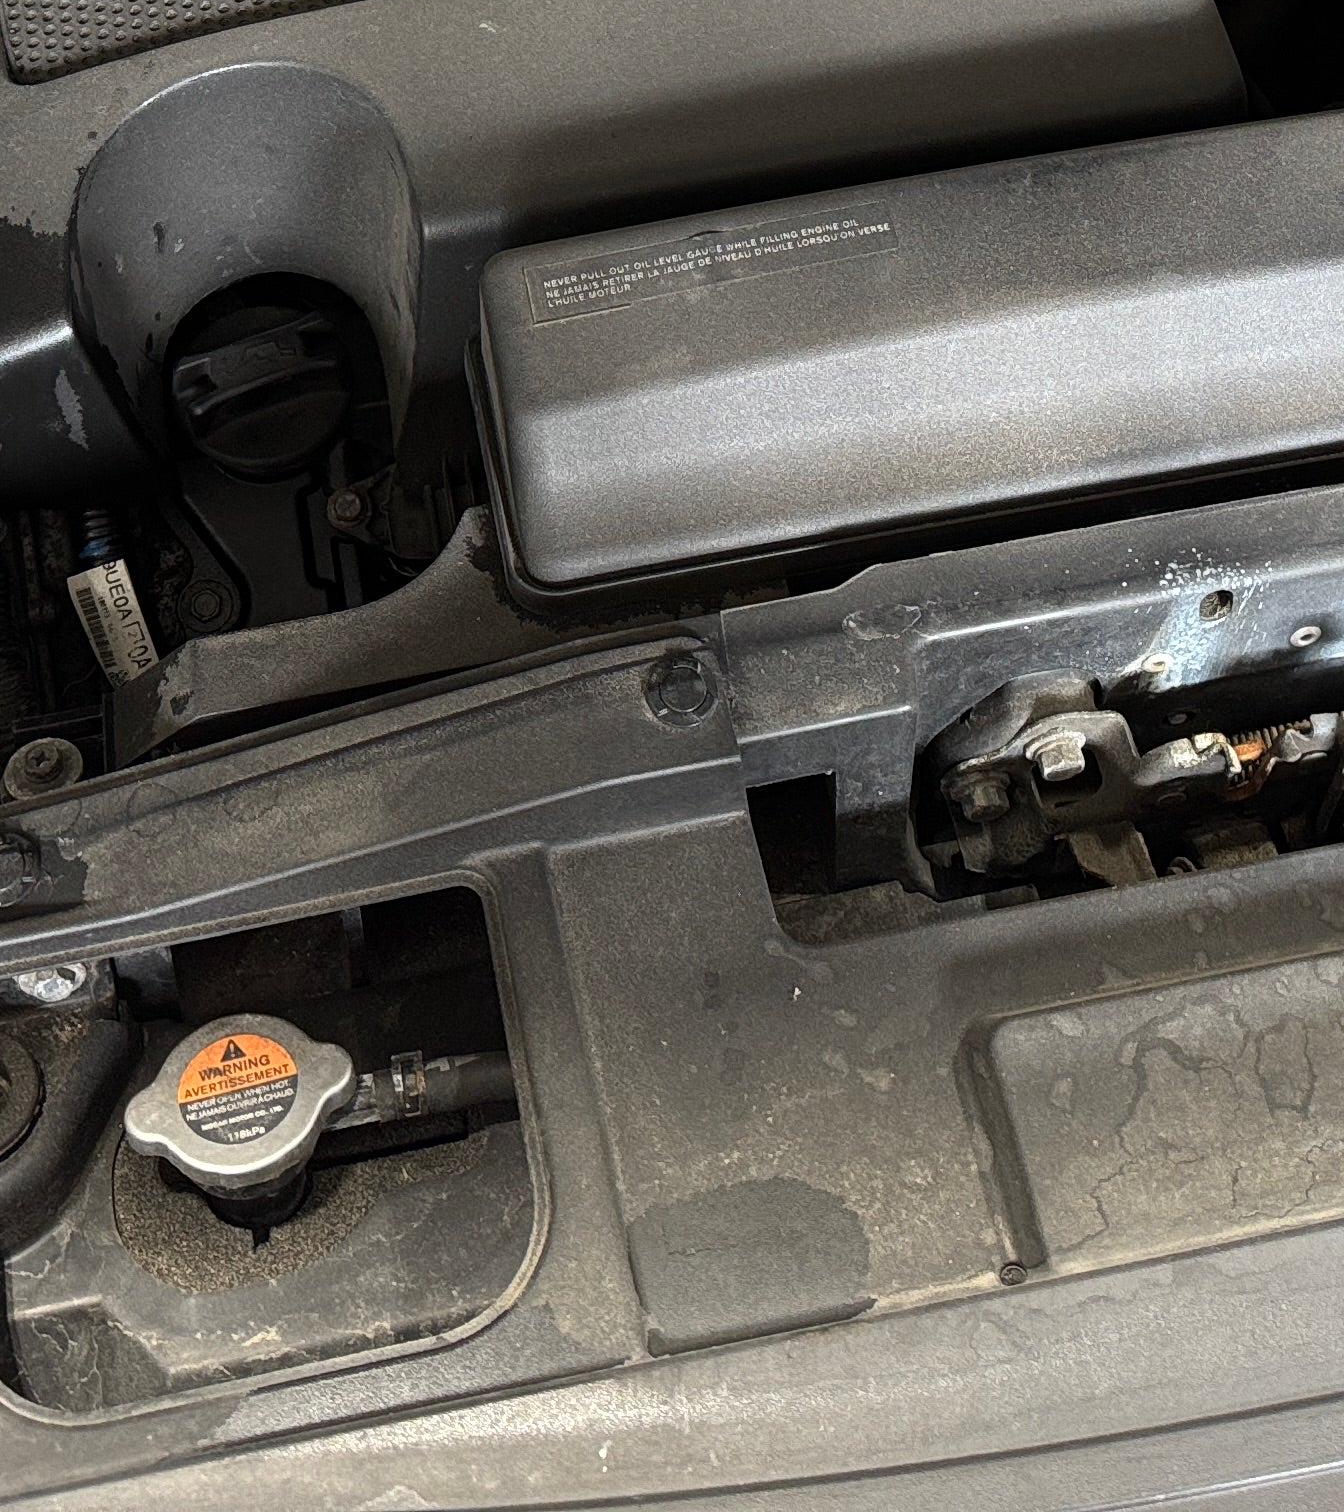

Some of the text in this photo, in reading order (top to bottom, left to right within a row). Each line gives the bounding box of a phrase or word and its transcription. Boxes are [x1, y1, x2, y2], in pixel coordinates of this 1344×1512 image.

[543, 219, 859, 289] NEVER PULL OUT OIL LEVEL GAUGE WHILE FILLING ENGINE OIL
[546, 289, 560, 299] NE
[563, 281, 599, 296] JAMAIS
[603, 273, 644, 287] RETIRER
[647, 269, 660, 279] LA
[663, 259, 696, 275] JAUGE
[698, 256, 712, 267] DE
[715, 250, 752, 264] NIVEAU
[754, 241, 795, 256] D'HUILE
[858, 222, 891, 236] VERSE
[548, 285, 632, 308] L'HUILE MOTEUR
[184, 1064, 290, 1100] AVERTISSEMENT
[199, 1054, 271, 1082] WARNING
[187, 1097, 216, 1112] NEVER
[217, 1091, 242, 1105] OPEN
